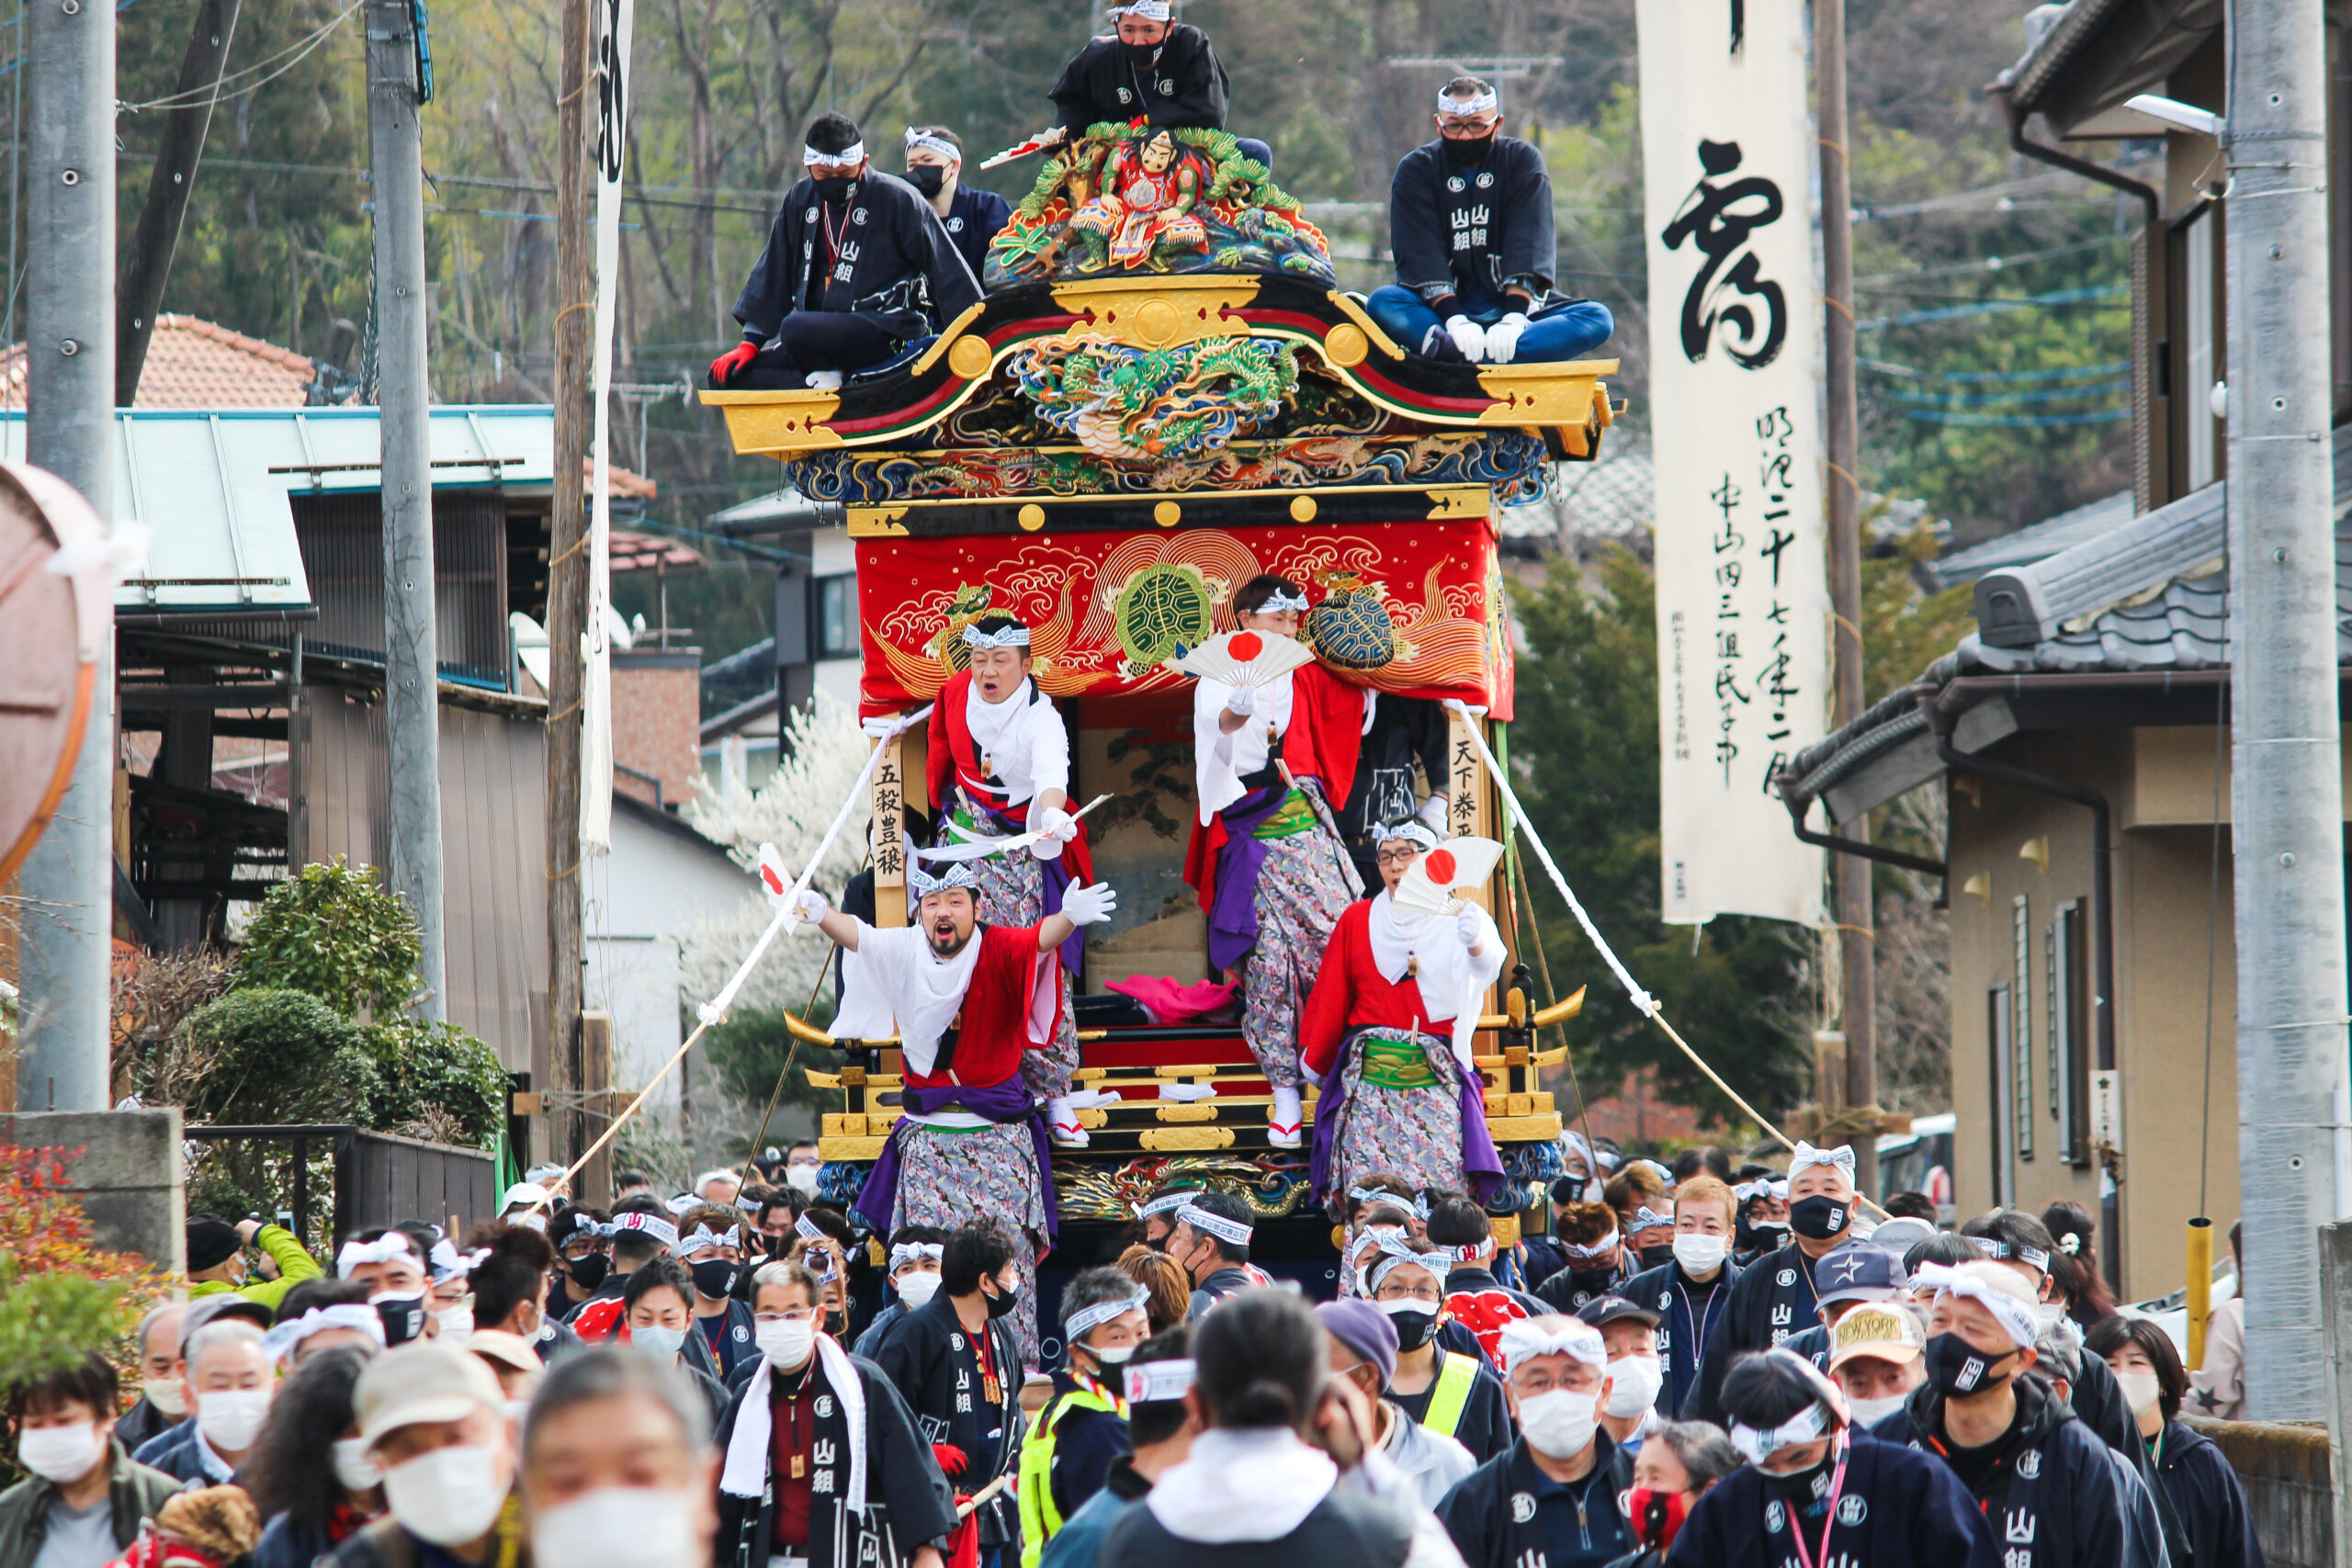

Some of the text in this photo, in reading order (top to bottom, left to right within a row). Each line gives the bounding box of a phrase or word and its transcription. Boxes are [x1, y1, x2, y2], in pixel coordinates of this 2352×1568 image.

[1451, 208, 1471, 251] 山組
[1471, 203, 1489, 246] 山組
[804, 240, 812, 281] 山
[833, 240, 860, 284] 山組
[874, 763, 902, 875] 五穀豊穣
[1838, 1316, 1897, 1348] NEW YORK
[956, 1368, 972, 1414] 山組
[812, 1438, 835, 1494] 山組
